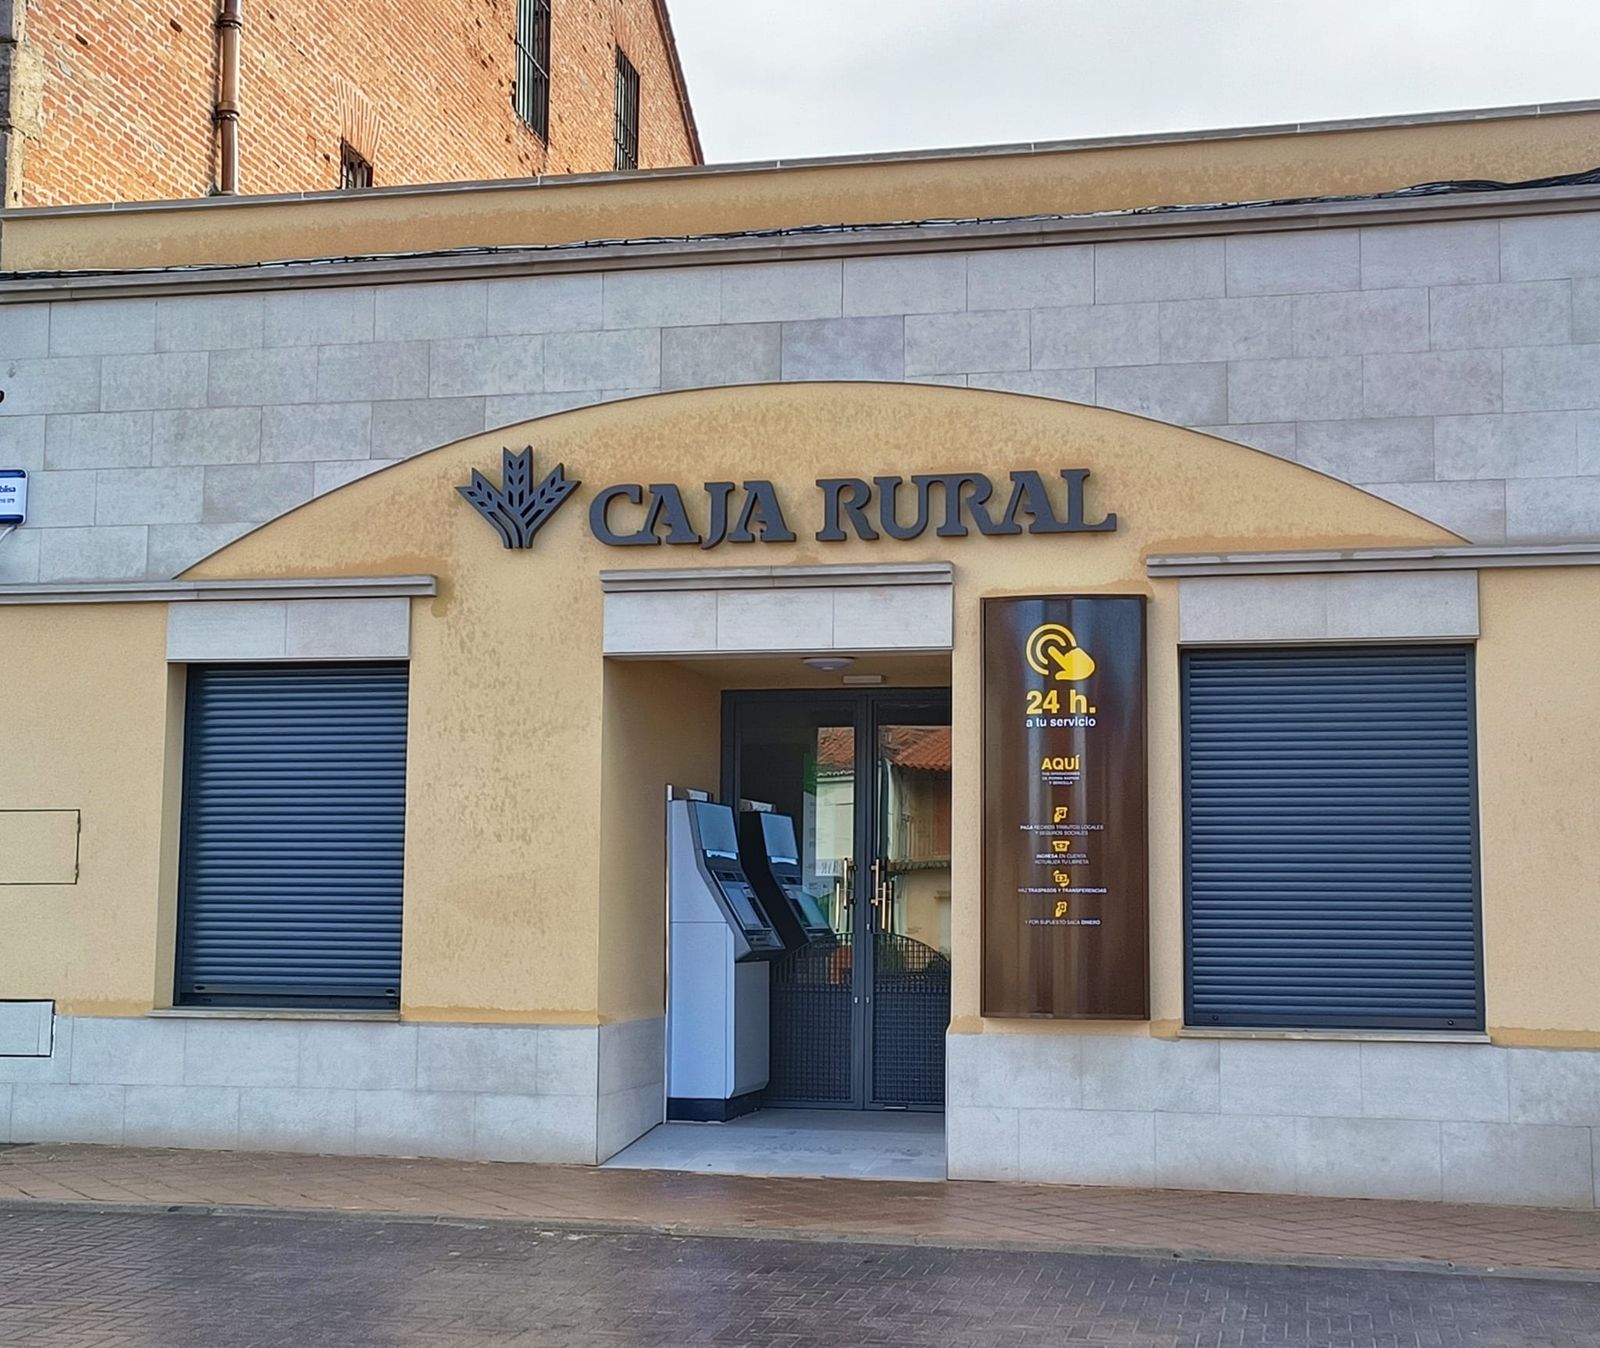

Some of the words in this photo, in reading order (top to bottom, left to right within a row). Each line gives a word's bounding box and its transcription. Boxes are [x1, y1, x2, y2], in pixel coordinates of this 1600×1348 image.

[588, 479, 797, 549] CAJA
[815, 469, 1118, 542] RURAL
[1026, 690, 1060, 714] 24
[1070, 689, 1096, 714] h.
[1026, 718, 1033, 727] a
[1036, 717, 1047, 727] tu
[1050, 716, 1096, 727] servicio
[1041, 754, 1080, 770] AQUÍ
